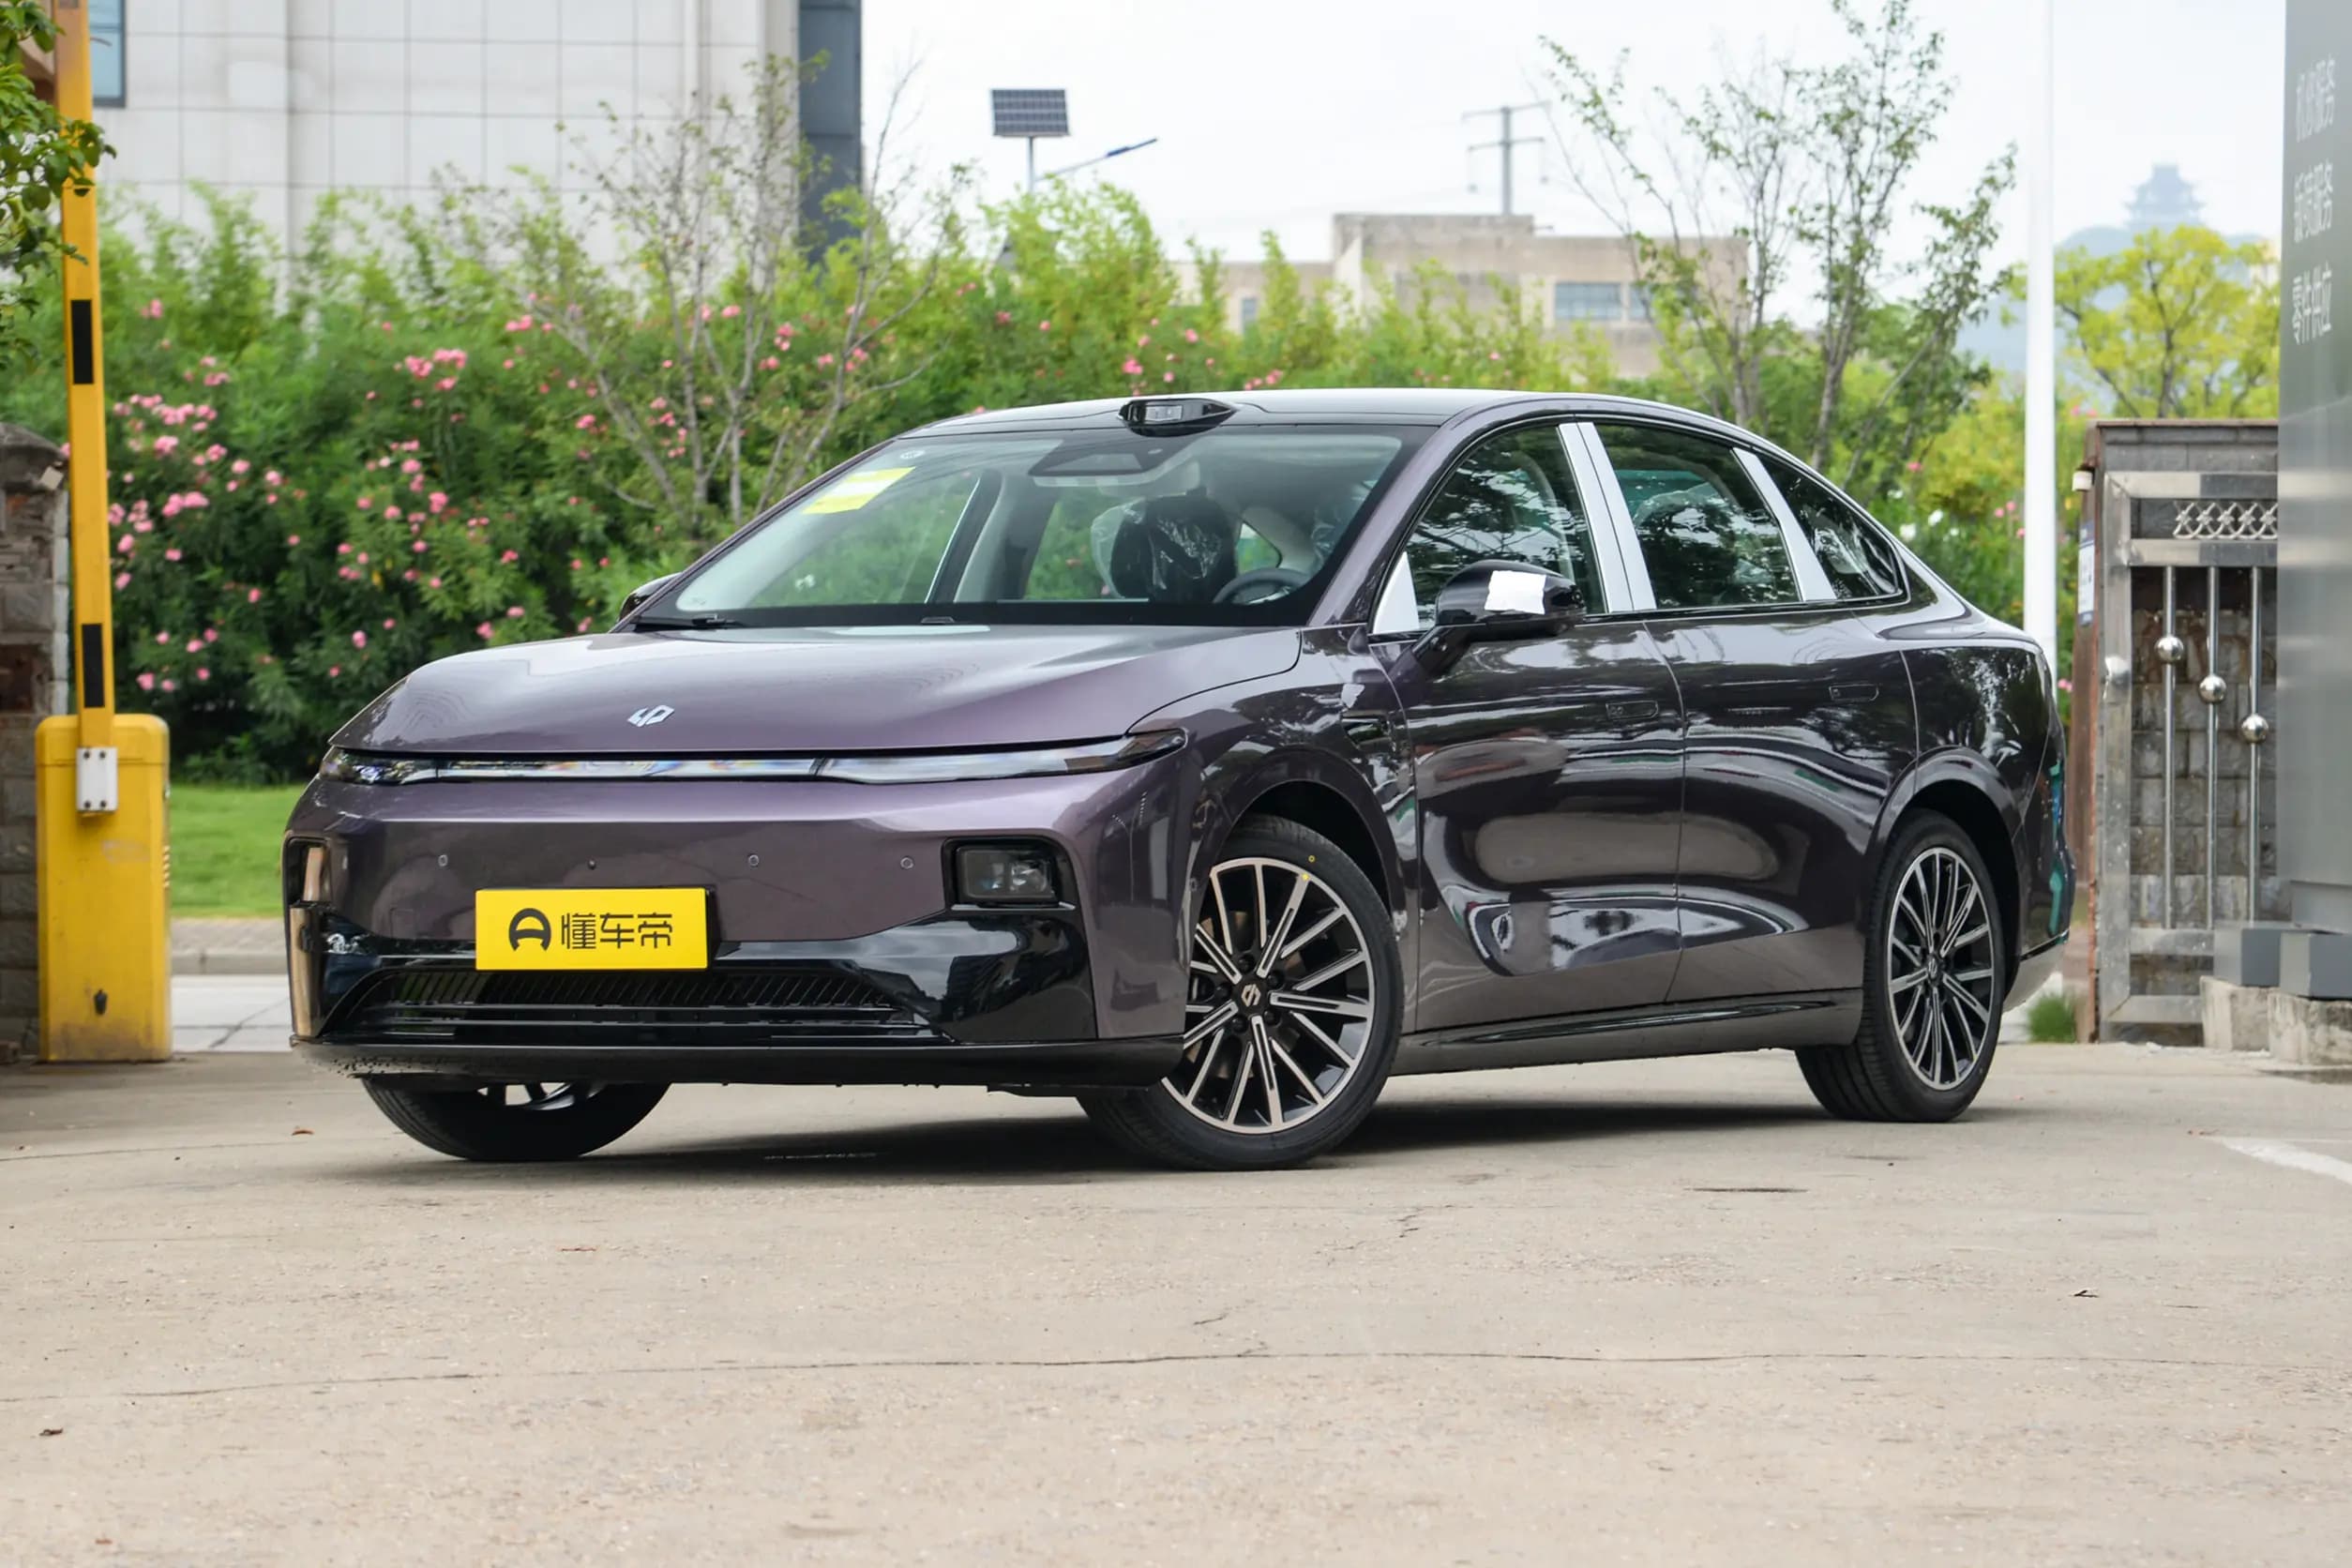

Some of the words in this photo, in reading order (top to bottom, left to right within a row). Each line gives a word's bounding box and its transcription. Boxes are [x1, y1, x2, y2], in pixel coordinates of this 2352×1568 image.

[2292, 260, 2332, 345] 零件供应
[561, 912, 673, 949] 懂车帝
